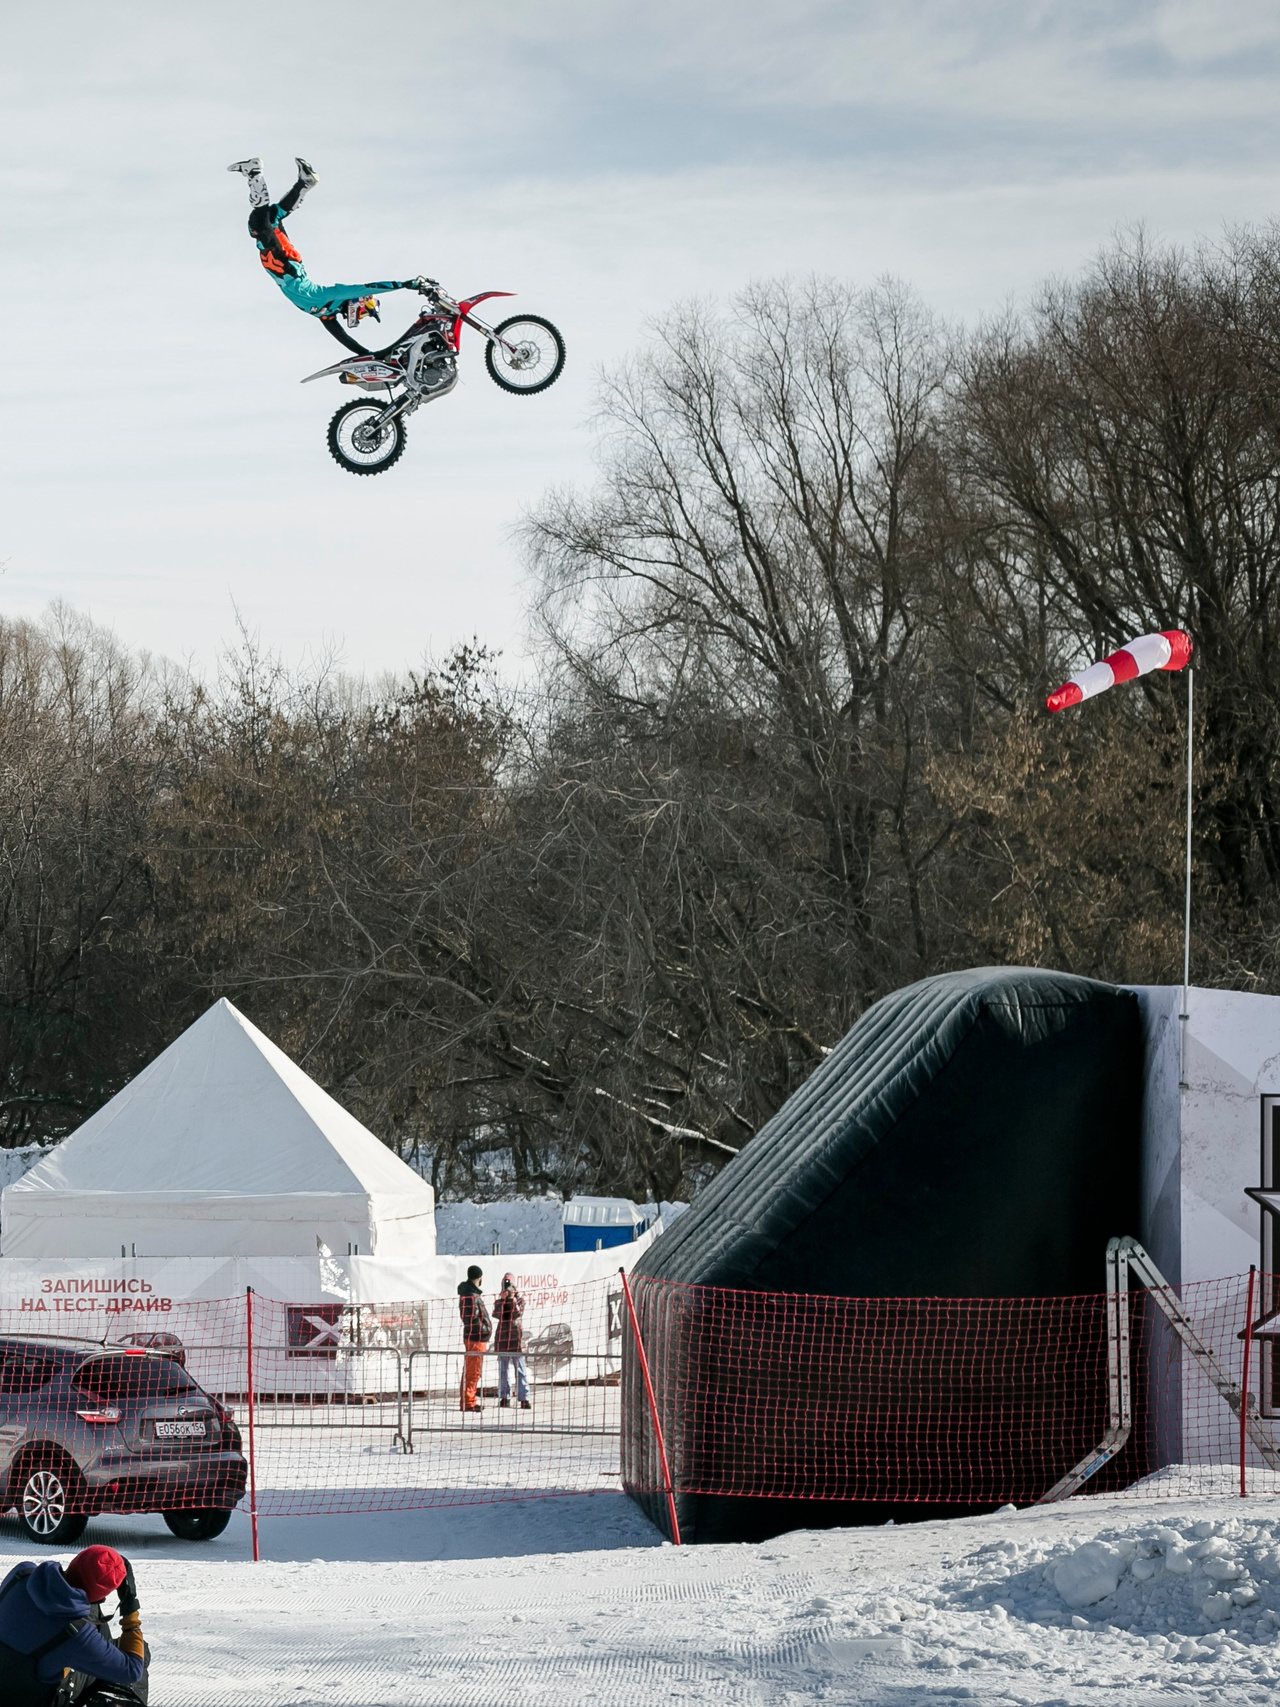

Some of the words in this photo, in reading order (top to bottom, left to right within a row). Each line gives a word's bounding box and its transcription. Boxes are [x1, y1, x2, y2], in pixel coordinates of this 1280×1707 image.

[41, 1279, 153, 1293] ЗАПИШИСЬ
[515, 1274, 558, 1288] ПИШИСЬ
[20, 1298, 47, 1312] НА
[53, 1295, 172, 1314] ТЕСТ-ДРАЙВ
